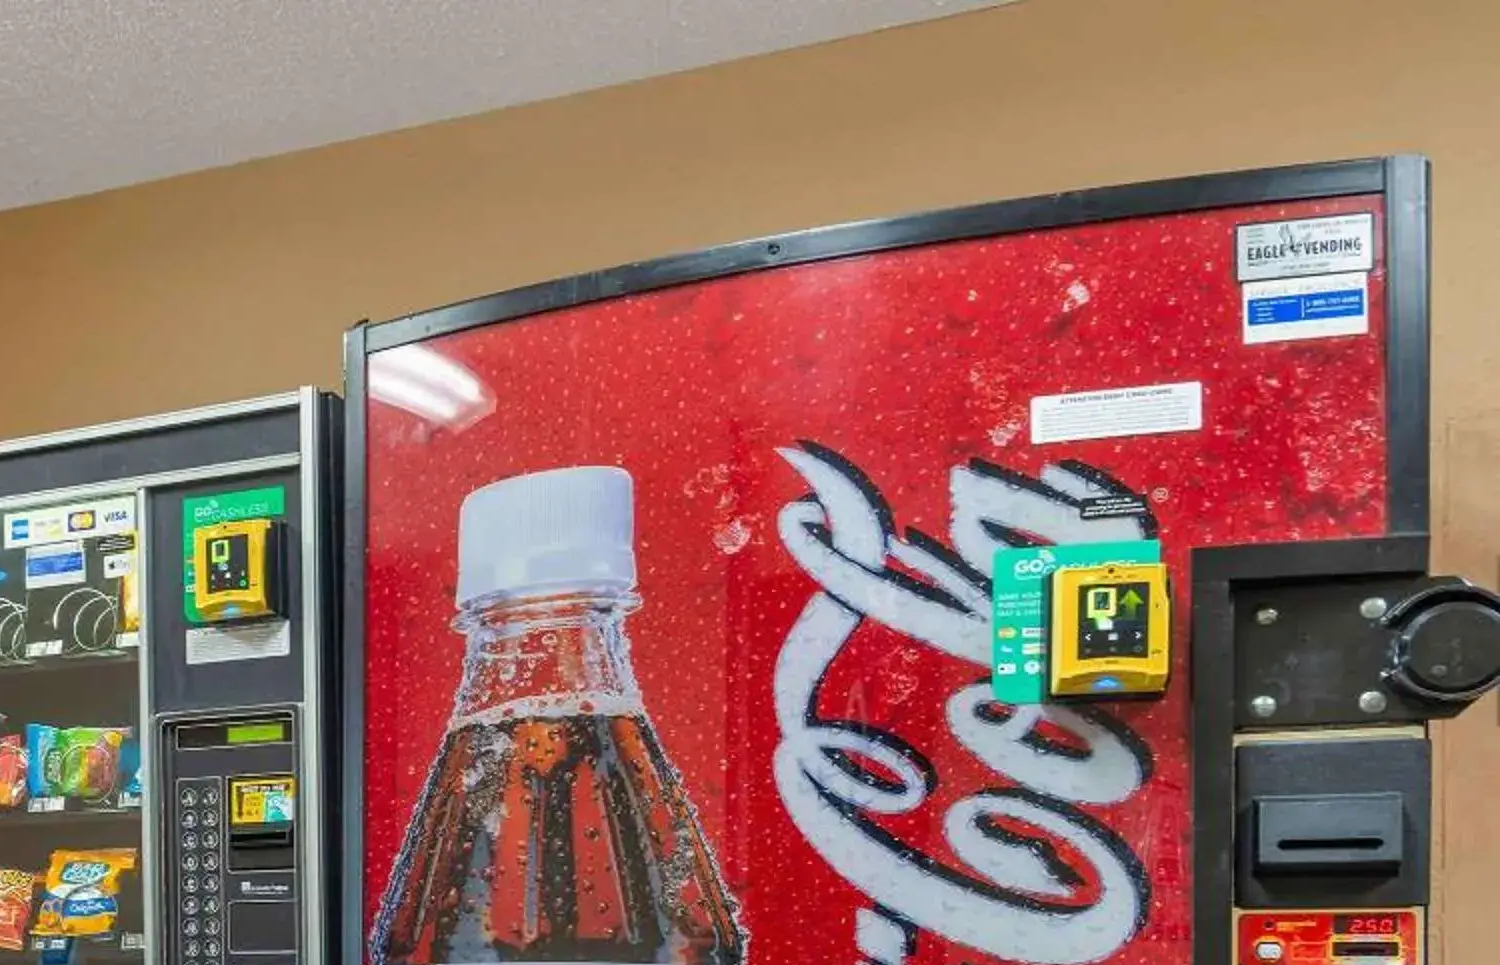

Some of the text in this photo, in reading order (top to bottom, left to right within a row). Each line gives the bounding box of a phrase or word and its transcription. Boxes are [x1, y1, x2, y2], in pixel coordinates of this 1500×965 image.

[1247, 237, 1363, 260] EAGLE VENDING
[1014, 559, 1044, 575] GO
